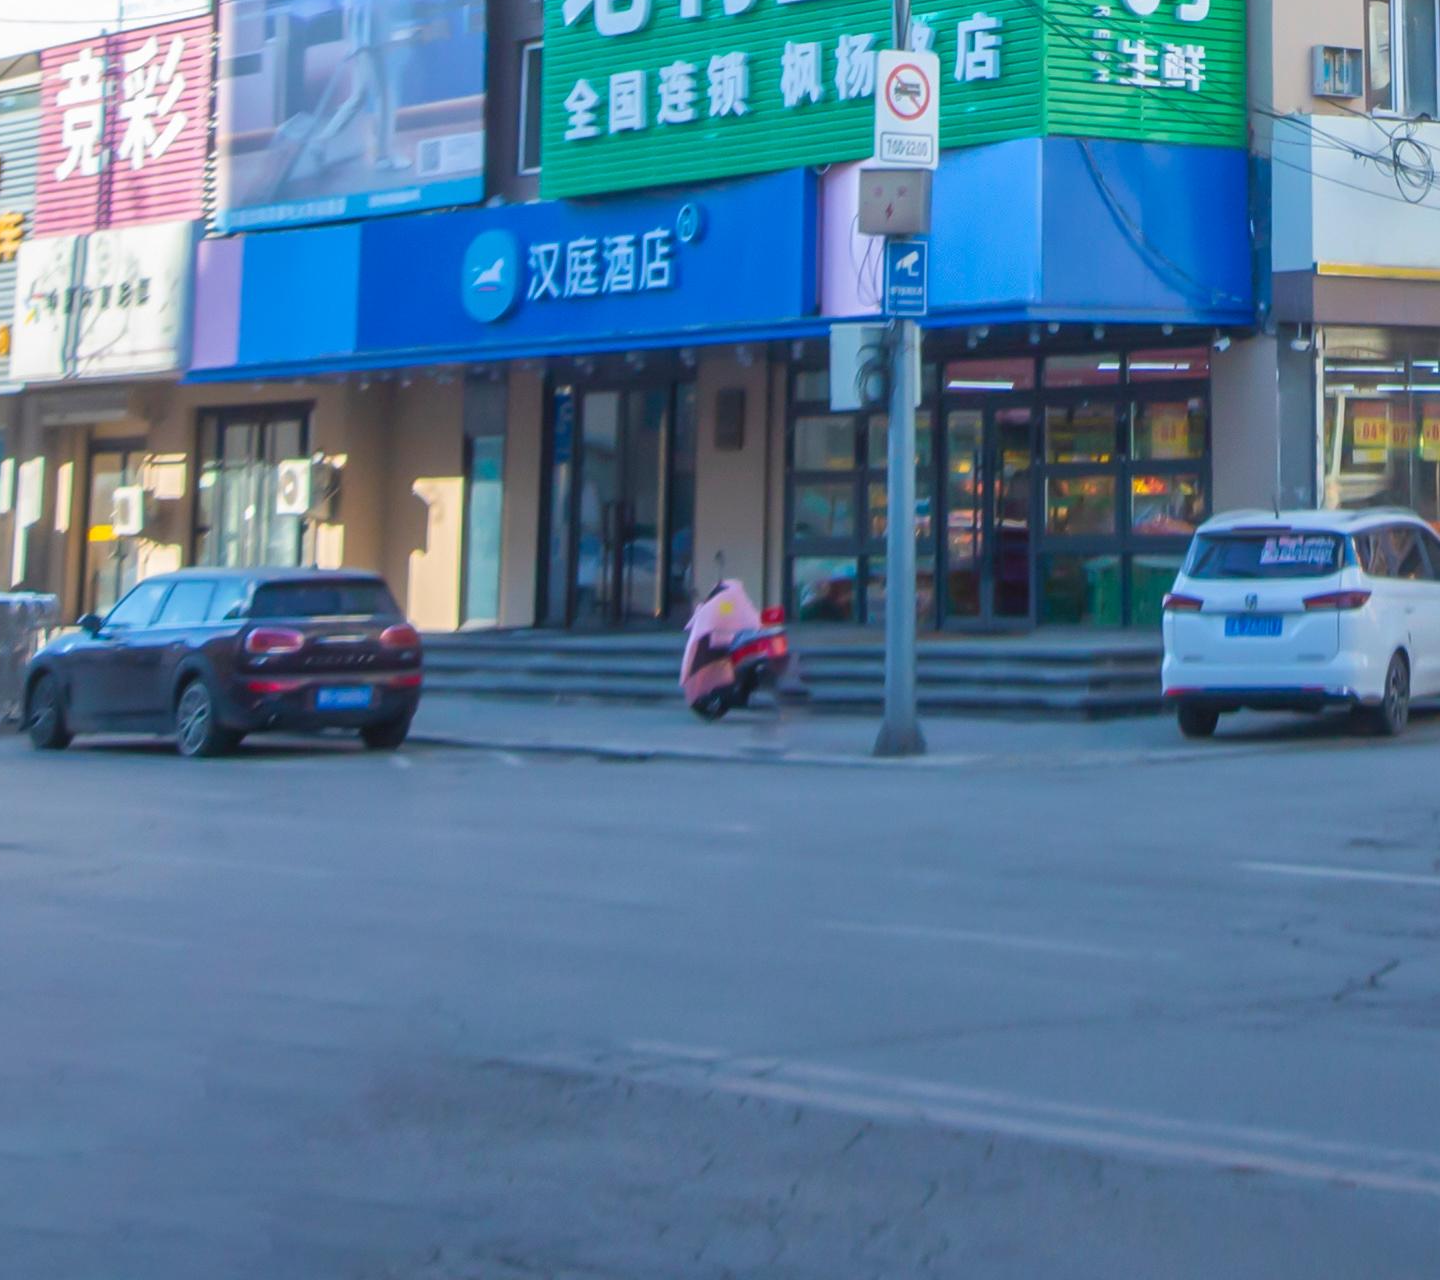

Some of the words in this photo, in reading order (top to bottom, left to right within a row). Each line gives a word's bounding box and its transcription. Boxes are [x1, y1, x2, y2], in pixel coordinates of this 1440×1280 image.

[55, 34, 190, 183] 竞彩
[564, 51, 748, 141] 全国连锁
[781, 11, 1002, 107] 枫杨店
[1114, 39, 1207, 92] 生鲜
[526, 226, 672, 301] 汉庭酒店
